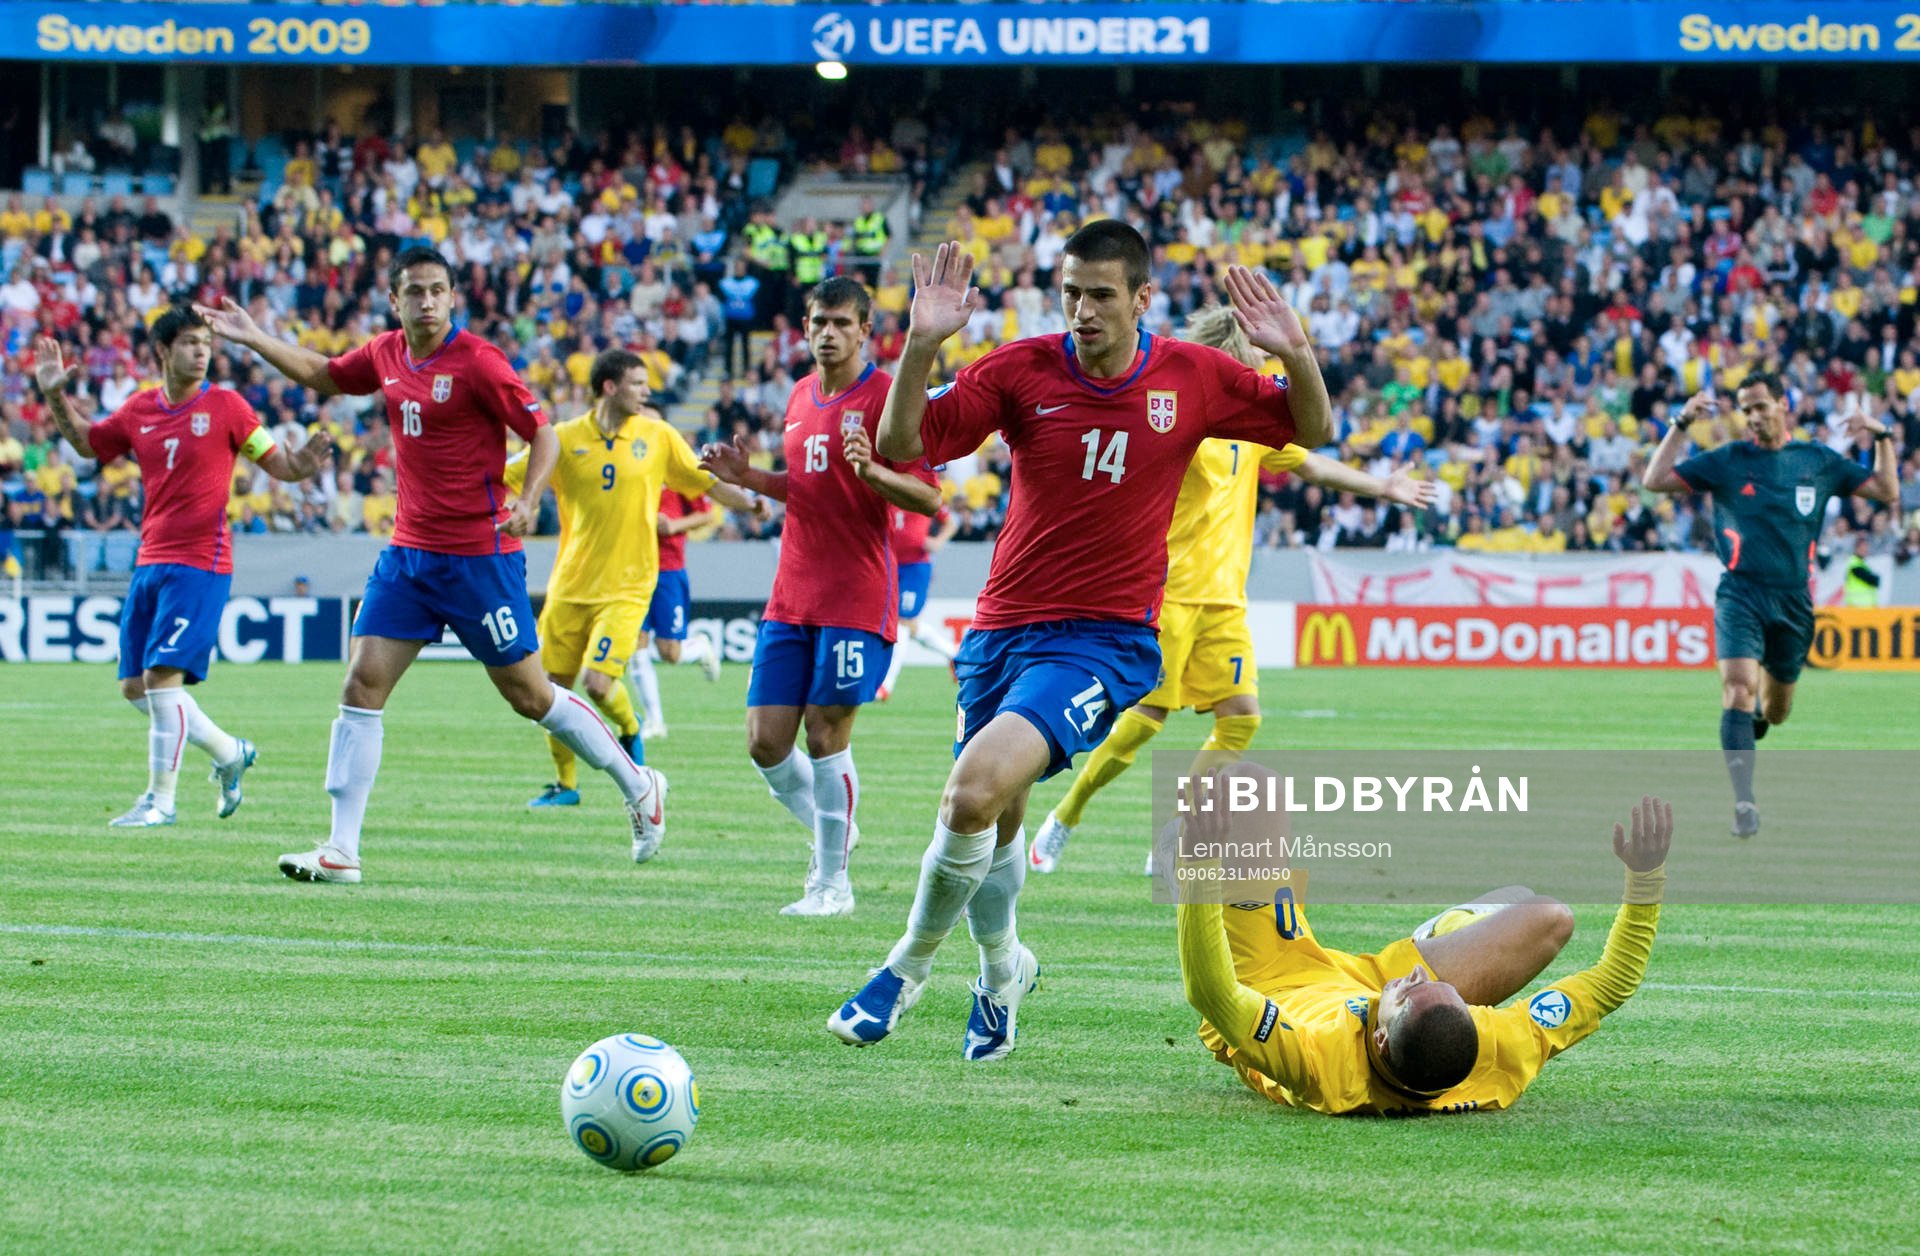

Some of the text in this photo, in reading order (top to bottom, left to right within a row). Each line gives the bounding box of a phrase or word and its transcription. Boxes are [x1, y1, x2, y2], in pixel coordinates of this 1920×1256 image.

[37, 14, 371, 55] Sweden 2009
[869, 17, 1209, 54] UEFA UNDER21
[1679, 14, 1880, 52] Sweden
[400, 400, 423, 437] 16
[164, 438, 179, 469] 7
[804, 434, 830, 473] 15
[1081, 429, 1129, 484] 14
[602, 464, 616, 490] 9
[167, 617, 190, 647] 7
[481, 605, 518, 646] 16
[1366, 616, 1709, 665] McDonald's
[593, 637, 612, 662] 9
[832, 640, 865, 678] 15
[1229, 657, 1243, 685] 7
[1258, 1004, 1277, 1041] RESPECT
